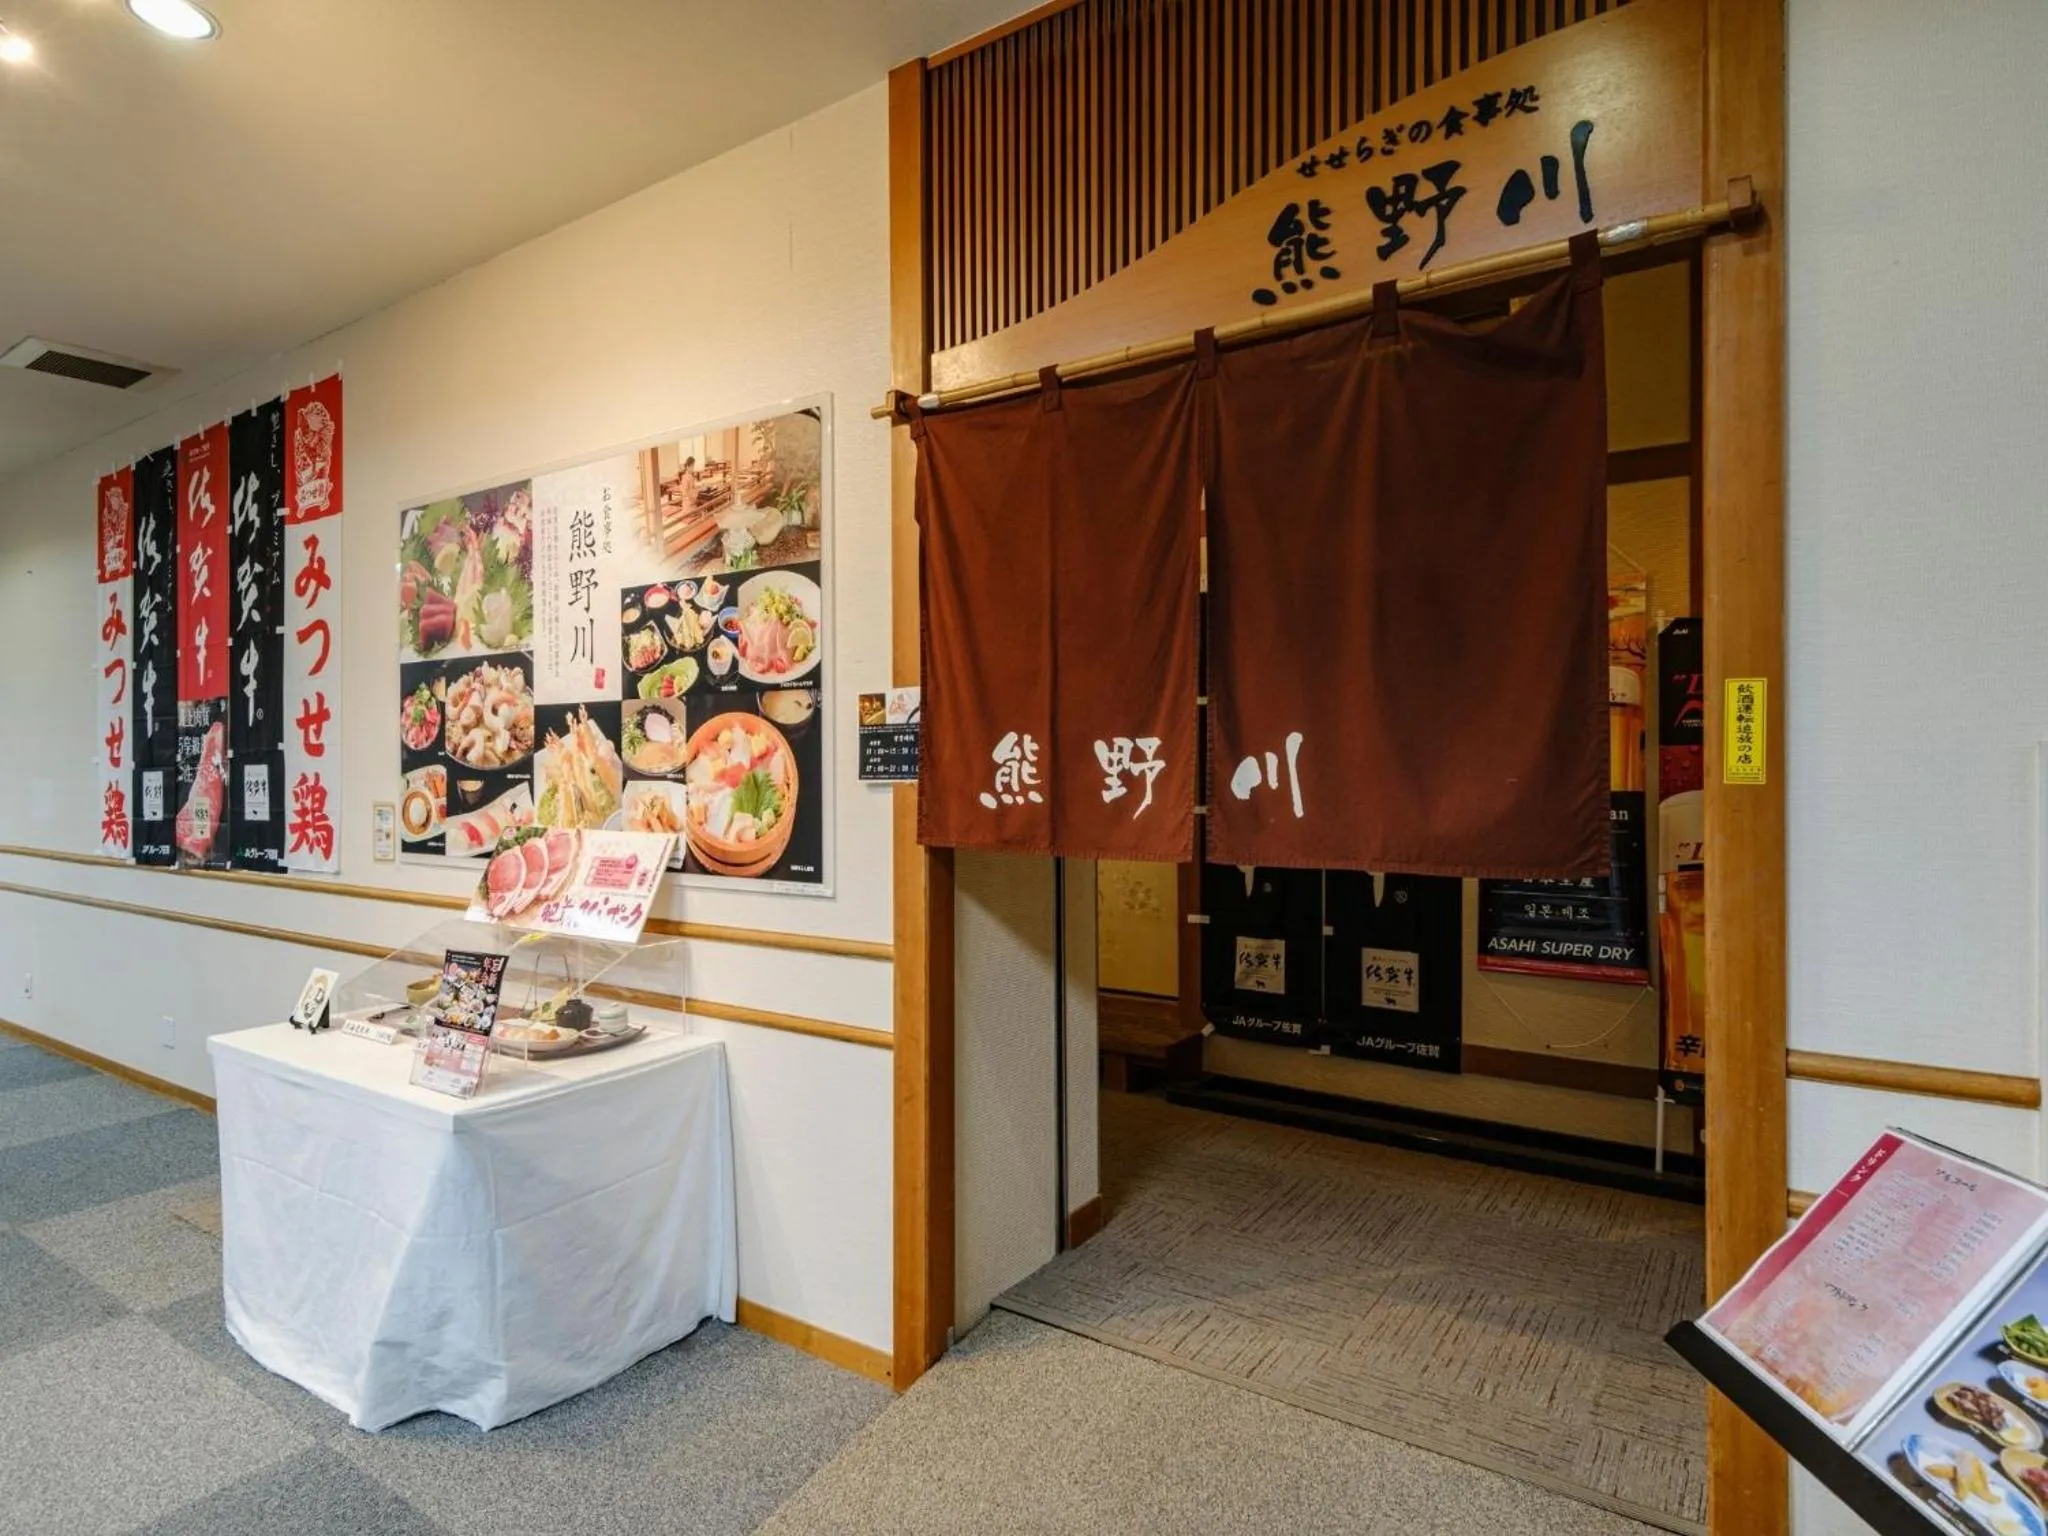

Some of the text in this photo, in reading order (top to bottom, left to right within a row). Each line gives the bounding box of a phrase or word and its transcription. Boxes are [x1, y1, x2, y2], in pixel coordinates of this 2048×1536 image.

[1296, 85, 1540, 178] せせらぎの食事処
[1251, 119, 1595, 306] 熊野川
[567, 509, 600, 666] 熊野川
[101, 592, 129, 850] みつせ鶏
[288, 533, 336, 862] みつせ鶏
[980, 731, 1304, 820] 熊野川
[1488, 937, 1635, 961] ASAHI SUPER DRY
[1232, 1014, 1302, 1035] JAグループ佐賀
[1356, 1035, 1440, 1059] JAグループ佐賀
